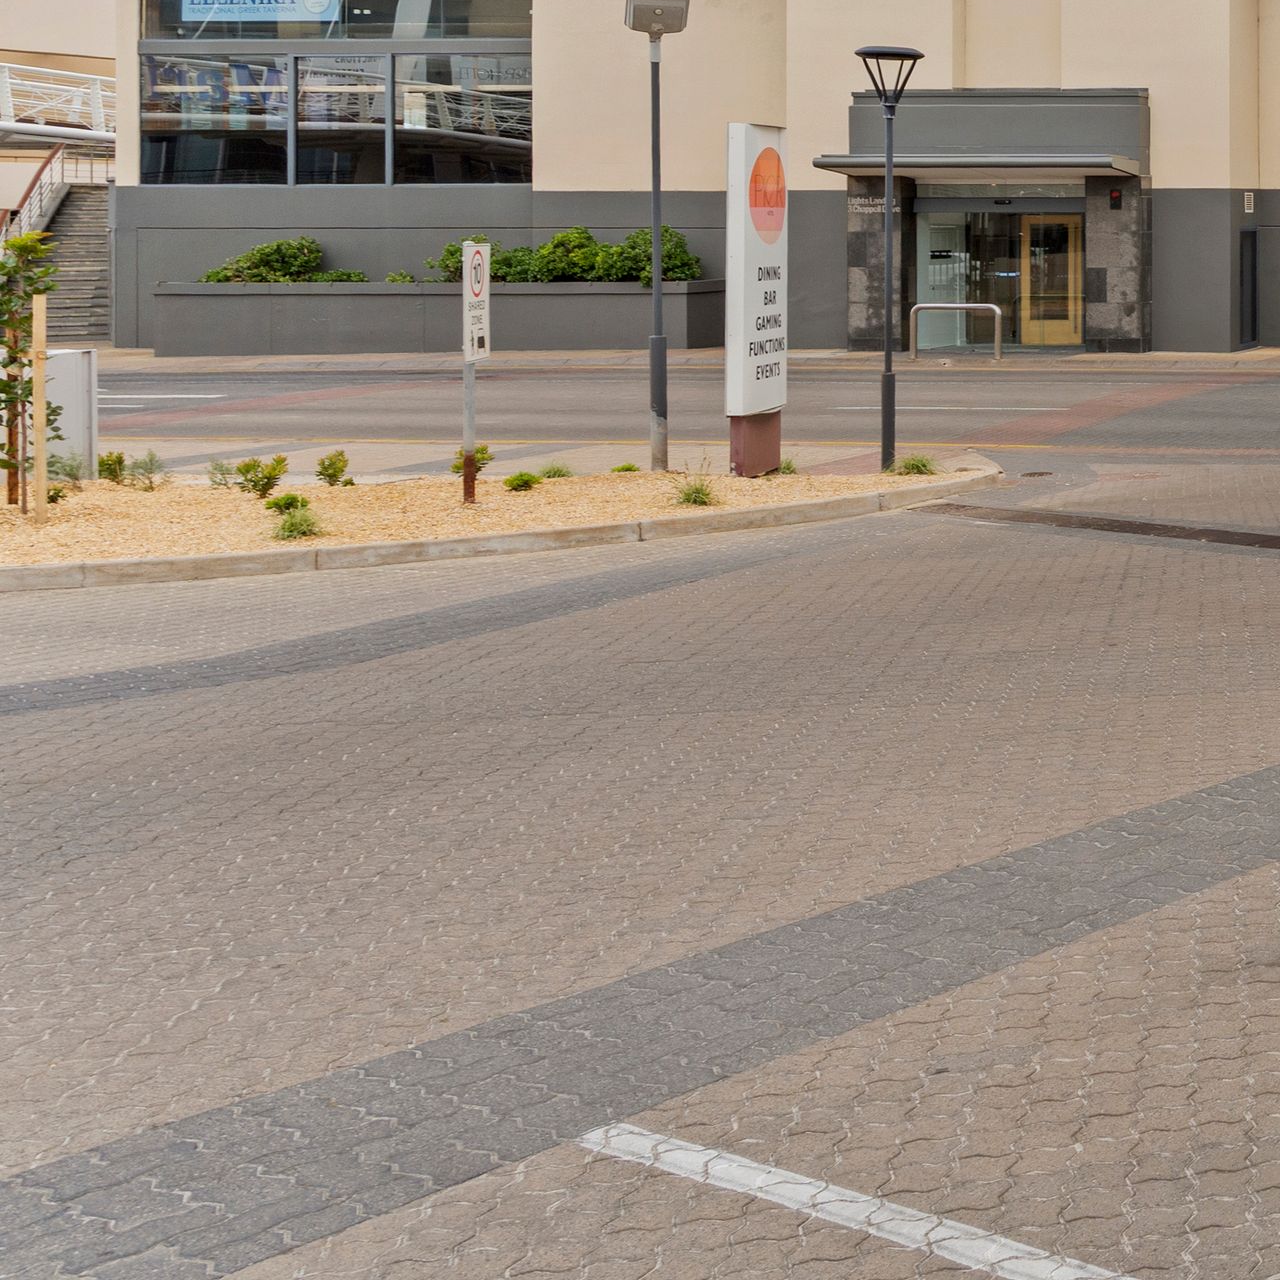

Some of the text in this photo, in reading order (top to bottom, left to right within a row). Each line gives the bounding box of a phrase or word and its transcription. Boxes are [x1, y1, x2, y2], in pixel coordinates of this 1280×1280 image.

[757, 266, 781, 282] DINING
[763, 290, 777, 306] BAR
[755, 313, 782, 331] GAMING
[749, 336, 786, 357] FUNCTIONS
[755, 361, 781, 381] EVENTS
